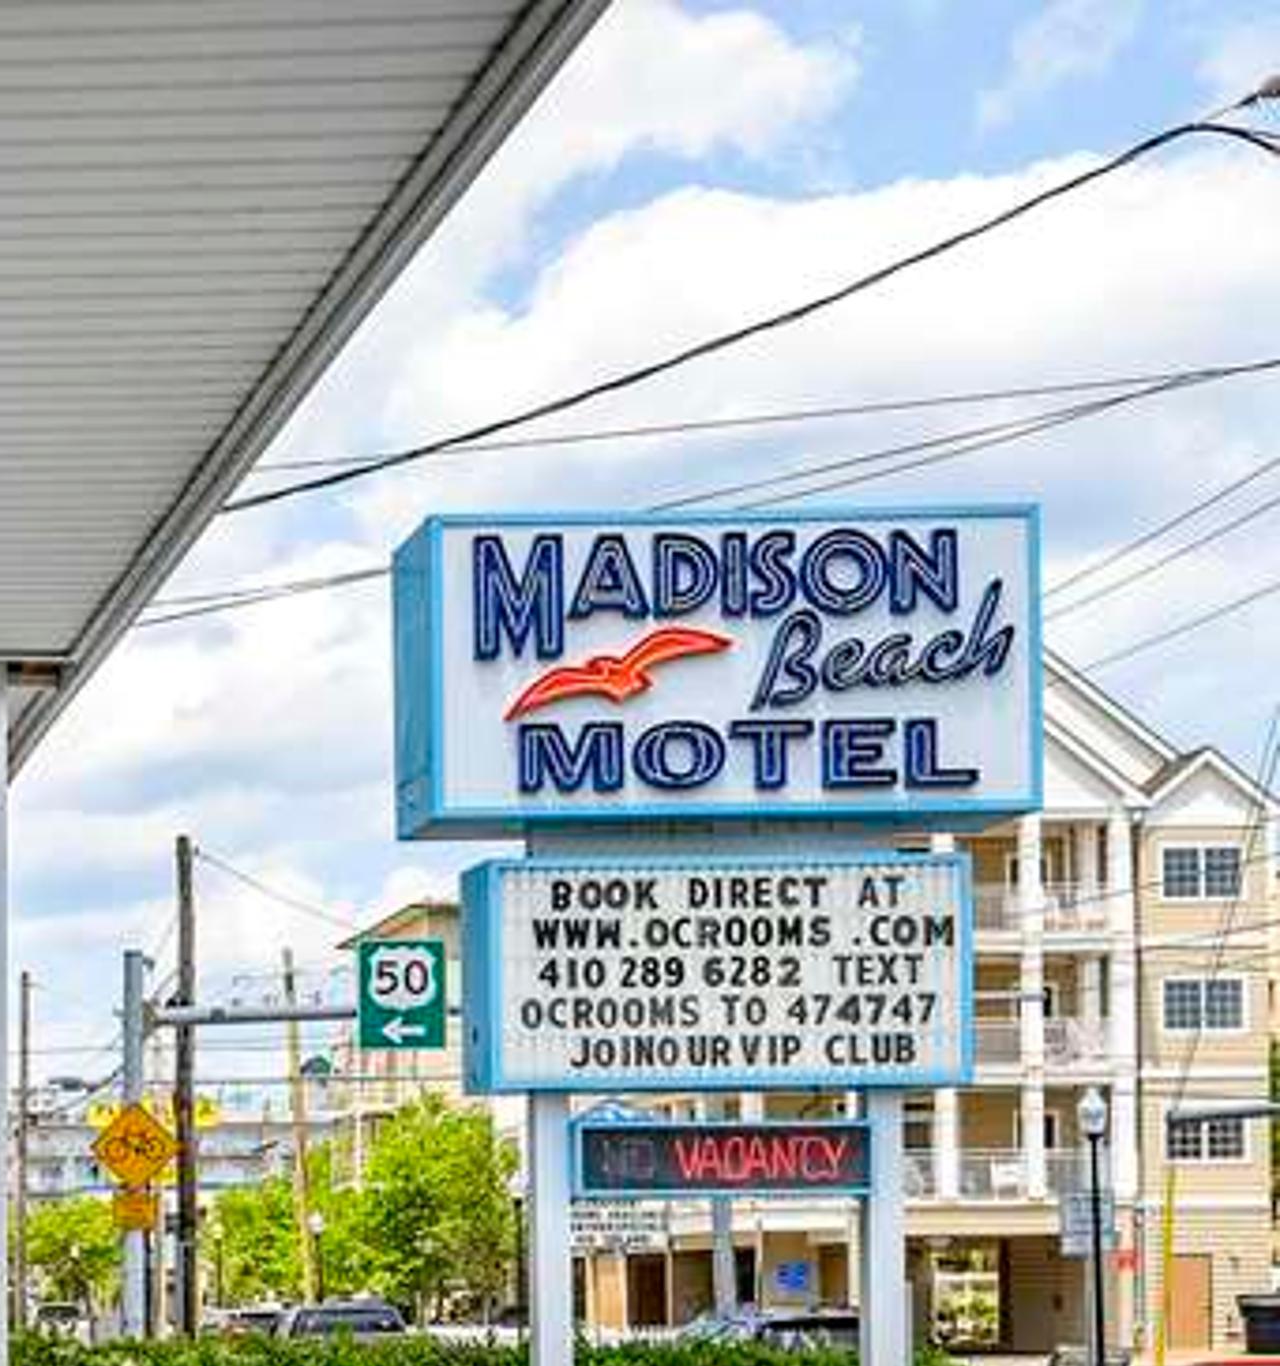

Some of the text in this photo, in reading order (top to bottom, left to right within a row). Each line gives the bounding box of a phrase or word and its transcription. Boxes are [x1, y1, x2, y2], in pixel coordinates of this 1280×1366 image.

[473, 528, 958, 661] MADISON
[750, 579, 1018, 712] Beach
[518, 719, 981, 793] MOTEL
[551, 876, 904, 912] BOOK DIRECT AT
[375, 960, 428, 995] 50
[538, 954, 924, 989] 410 289 6282 TEXT
[521, 993, 937, 1030] OCROOMS TO 474747
[824, 1034, 917, 1065] CLUB
[674, 1135, 850, 1180] VACANCY
